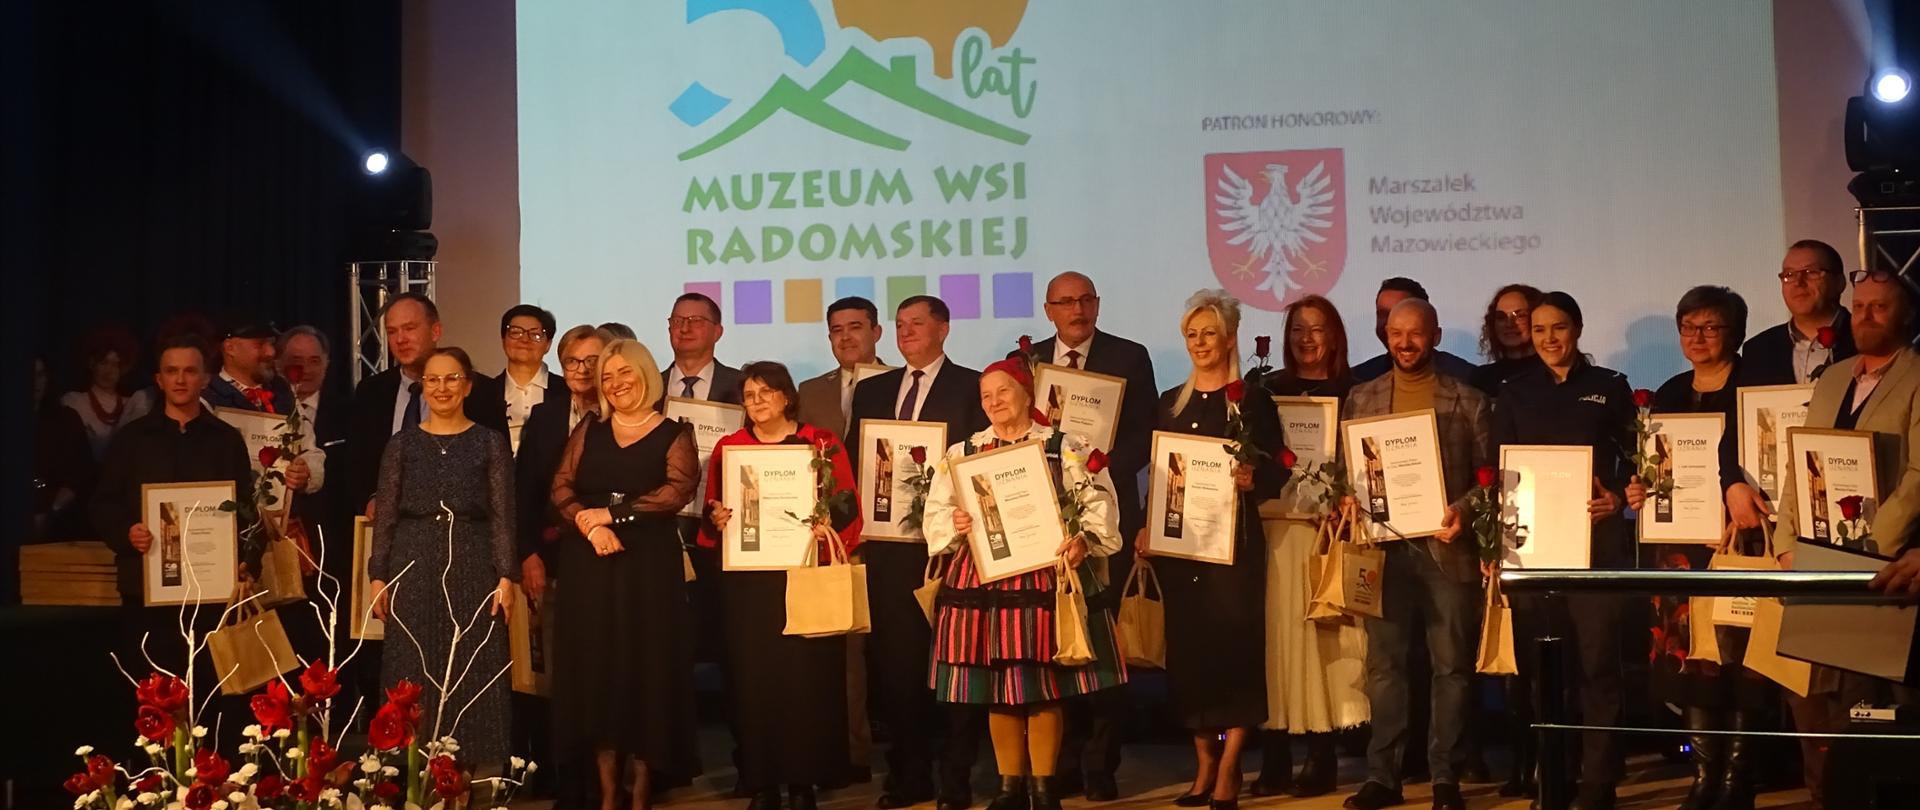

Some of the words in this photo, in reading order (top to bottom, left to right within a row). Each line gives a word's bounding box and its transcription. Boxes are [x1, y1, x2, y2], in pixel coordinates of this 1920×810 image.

[961, 35, 1036, 119] lat
[1202, 115, 1268, 131] PATRON
[682, 168, 914, 213] MUZEUM
[934, 162, 1026, 204] WSI
[1369, 203, 1524, 228] Województwa
[687, 216, 1028, 265] RADOMSKIEJ
[1371, 234, 1541, 255] Mazowieckiego
[1071, 394, 1102, 404] DYPLOM
[1781, 411, 1808, 419] DYPLO
[698, 424, 726, 433] DYPLOM
[1385, 436, 1417, 447] DYPLOM
[1191, 459, 1222, 468] DYPLOM
[1828, 457, 1858, 466] DYPLOM
[994, 467, 1027, 481] DYPLOM
